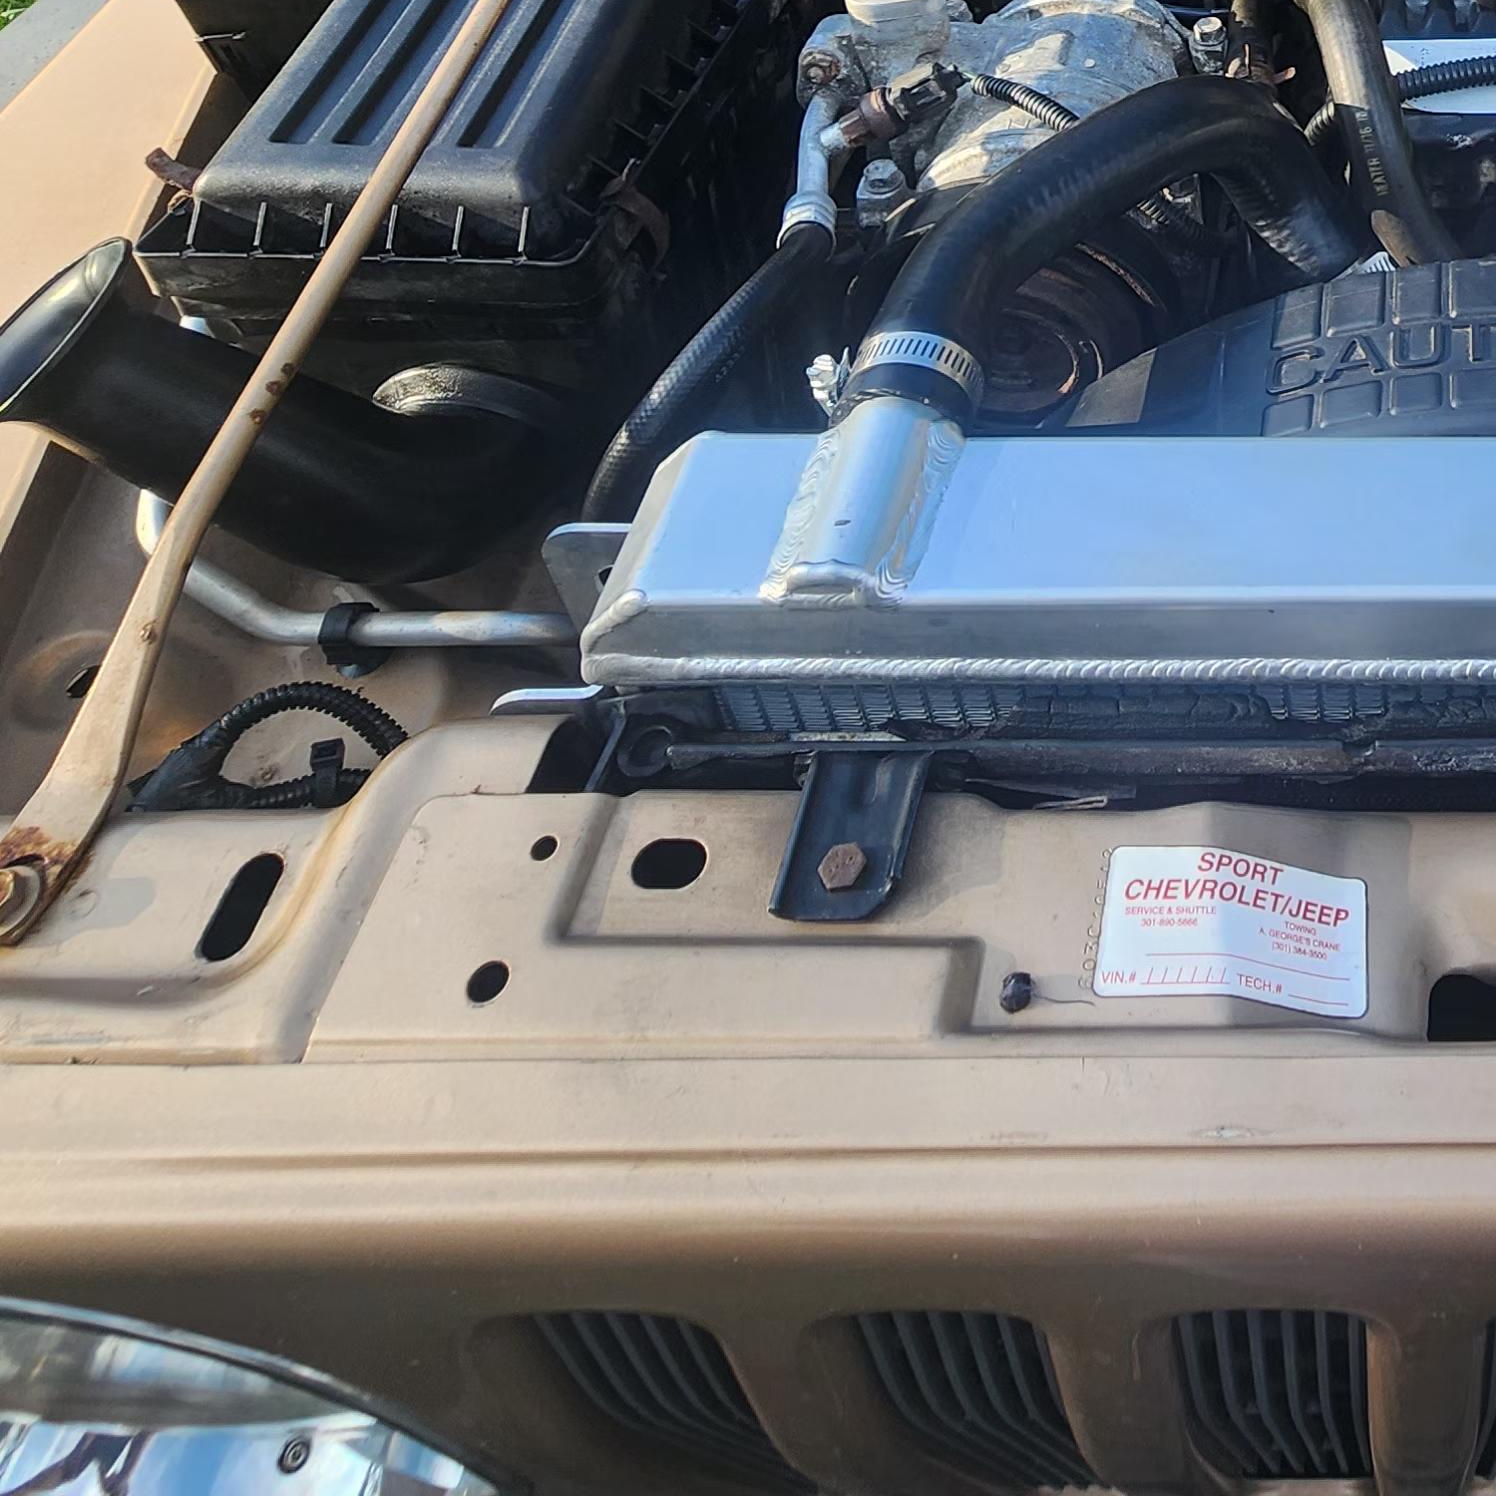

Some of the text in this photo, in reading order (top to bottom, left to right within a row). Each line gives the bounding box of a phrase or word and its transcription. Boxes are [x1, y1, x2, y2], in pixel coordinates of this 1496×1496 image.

[1197, 852, 1284, 886] SPORT
[1124, 879, 1350, 928] CHEVROLET/JEEP
[1125, 906, 1217, 915] SERVICE & SHUTTLE
[1285, 921, 1317, 936] TOWING
[1268, 929, 1311, 946] GEORGE'S
[1312, 939, 1341, 952] CRANE
[1101, 971, 1283, 994] VIN.# TECH.#
